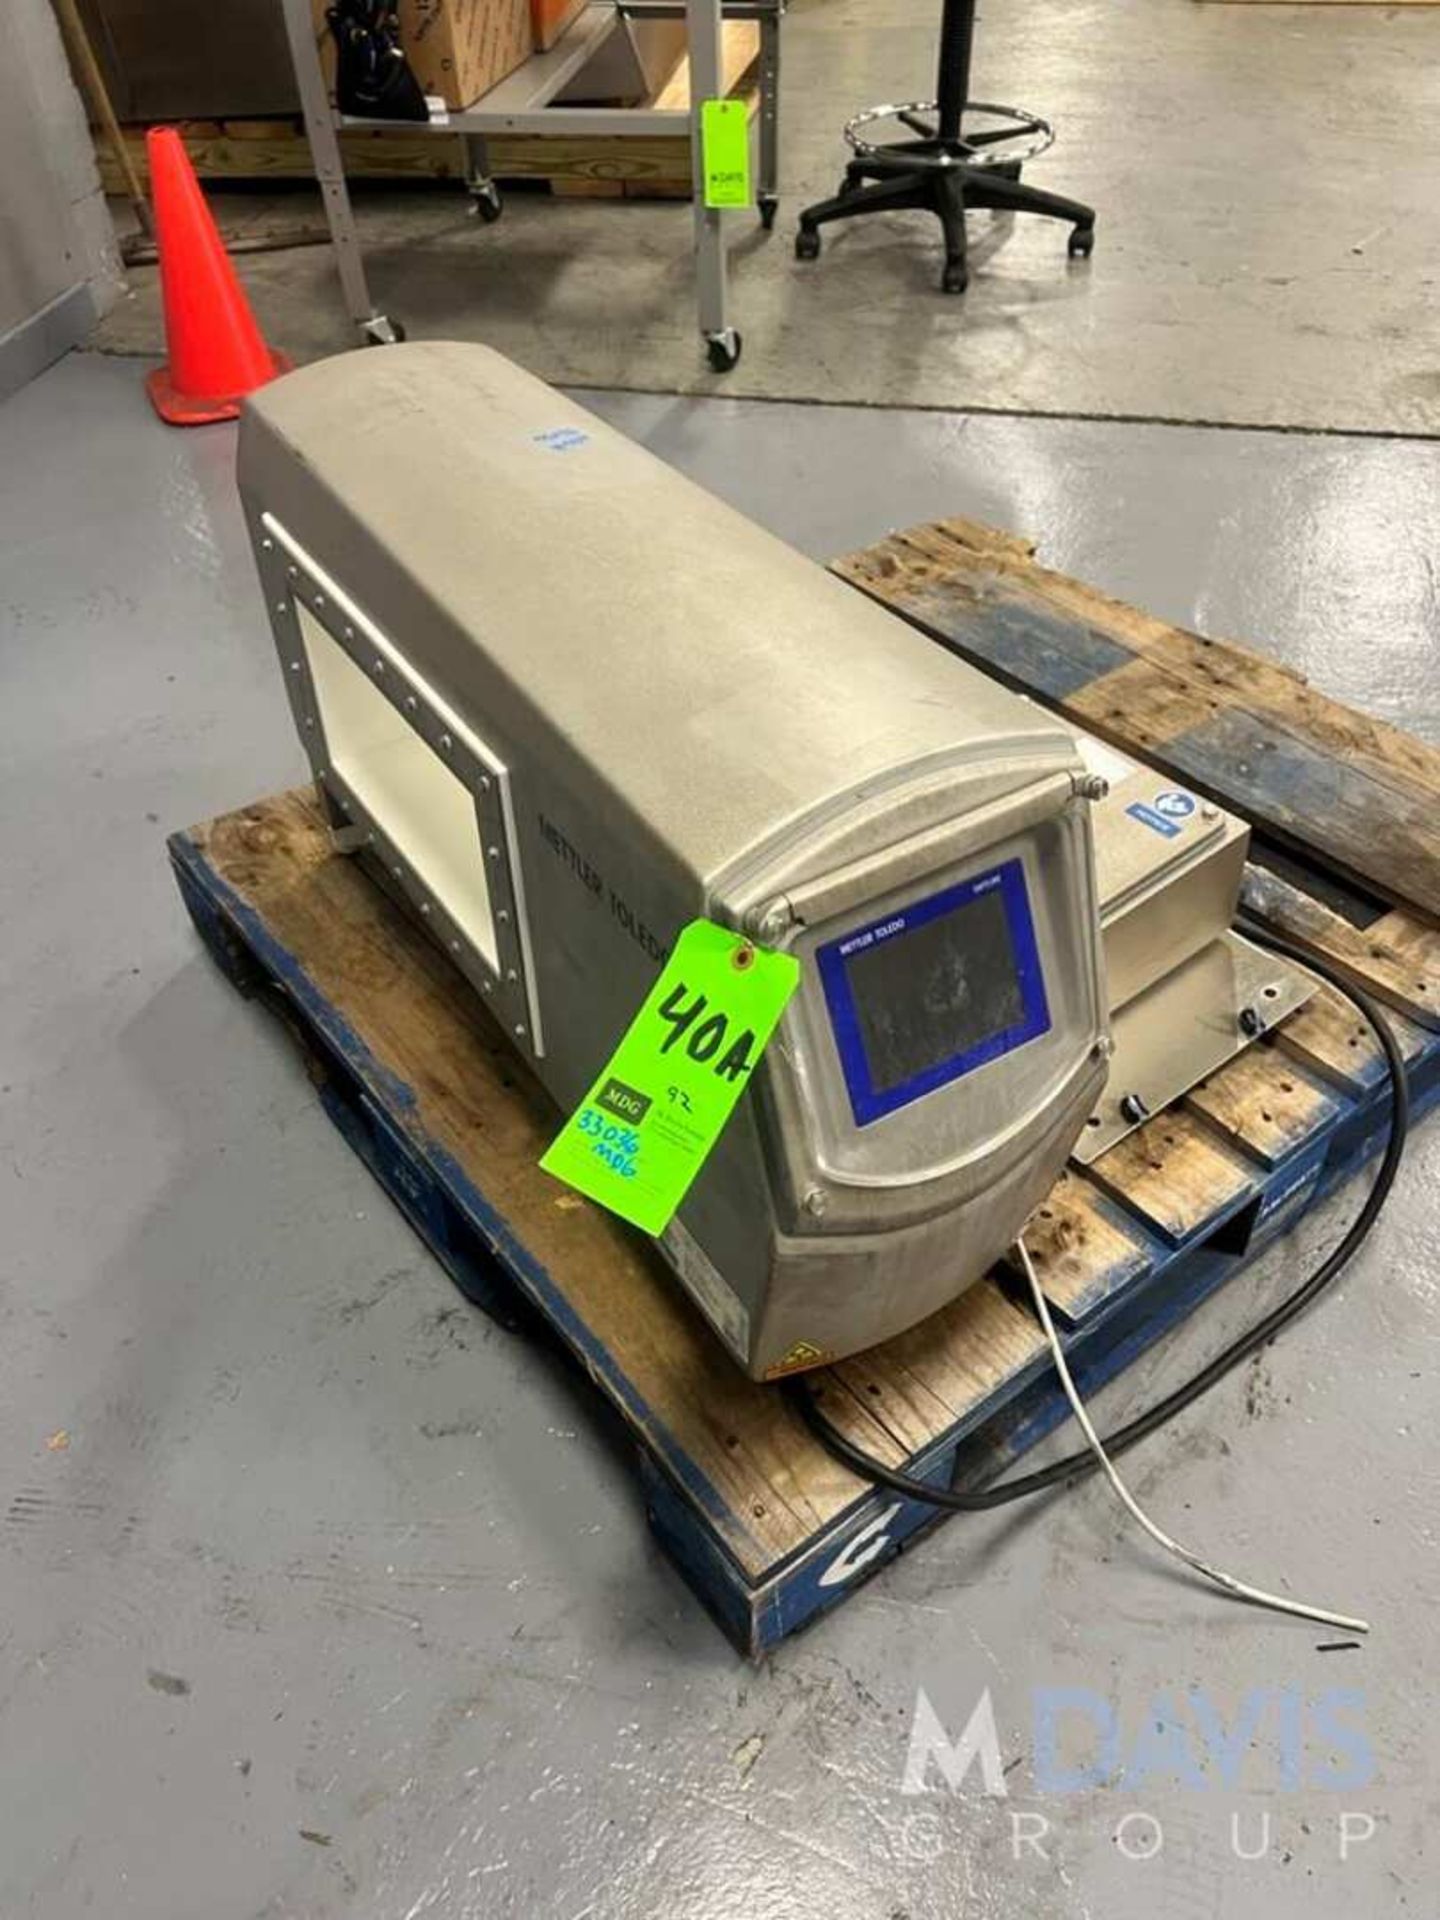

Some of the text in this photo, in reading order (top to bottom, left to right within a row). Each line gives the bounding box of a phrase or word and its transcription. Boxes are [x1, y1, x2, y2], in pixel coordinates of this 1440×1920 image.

[538, 813, 603, 898] METTLER
[839, 917, 905, 955] METTLER TOLEDO
[658, 981, 755, 1083] 40A
[605, 1089, 642, 1115] MDG
